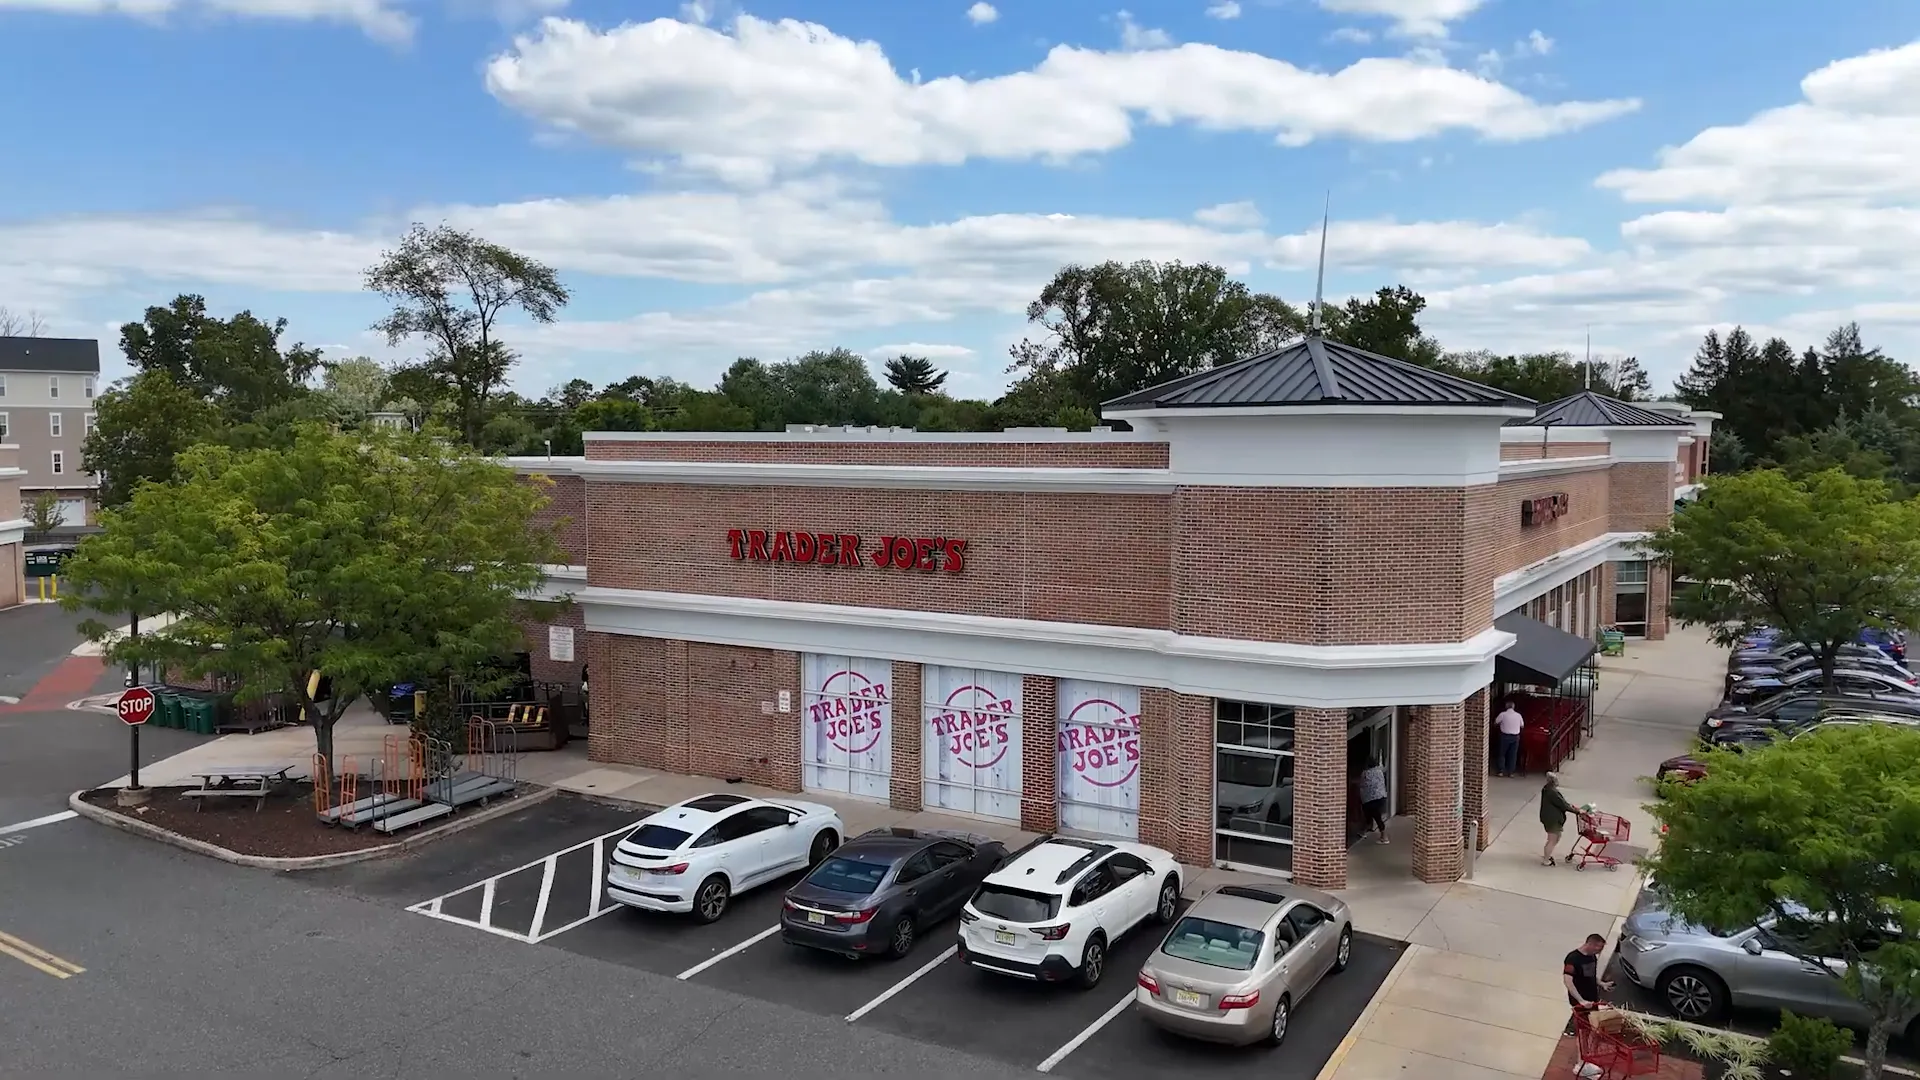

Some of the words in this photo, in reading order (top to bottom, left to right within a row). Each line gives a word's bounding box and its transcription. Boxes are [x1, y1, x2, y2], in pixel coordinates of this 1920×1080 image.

[727, 529, 862, 567] TRADER
[871, 536, 967, 572] JOE'S
[120, 697, 152, 715] STOP
[810, 684, 890, 723] TRADER
[932, 699, 1014, 736] TRADER
[826, 710, 882, 740] JOE'S
[950, 722, 1009, 754] JOE'S
[1073, 739, 1139, 772] JOE'S
